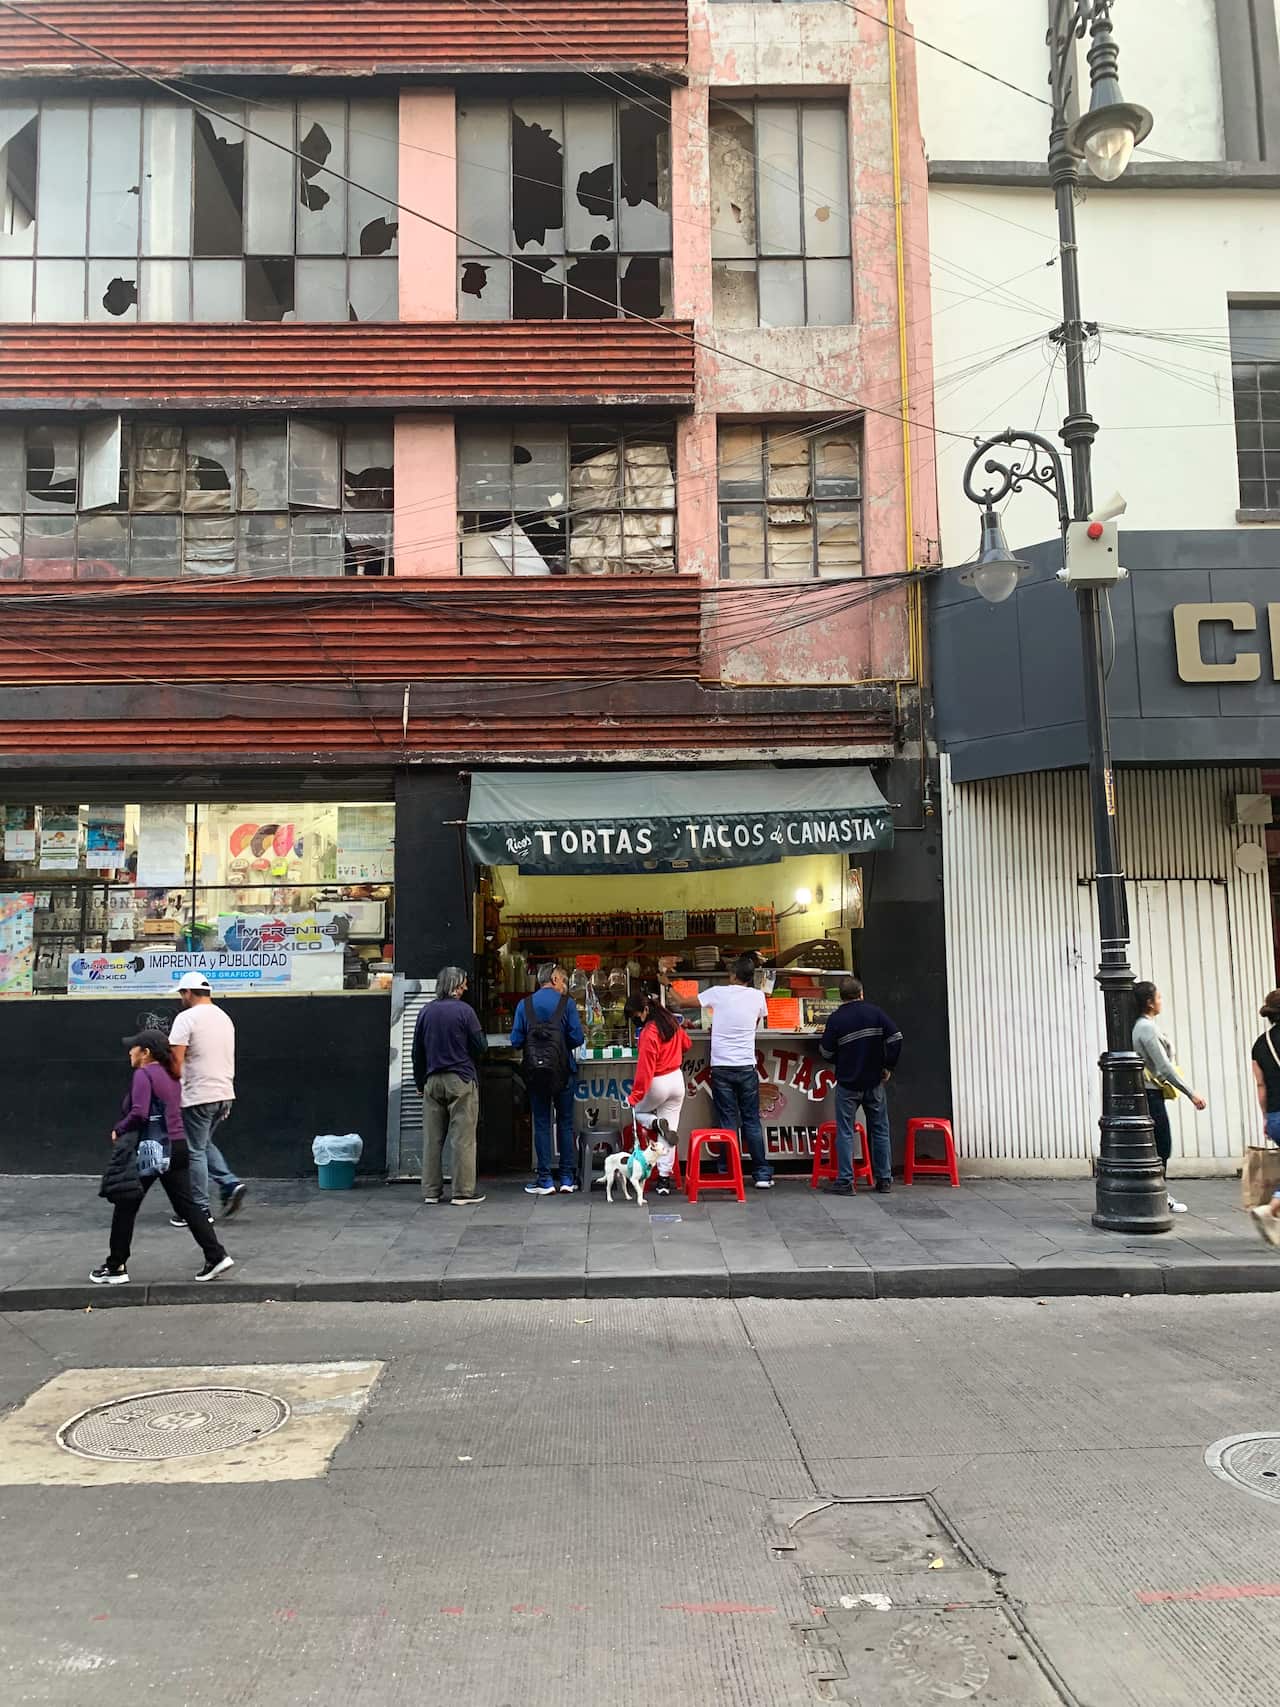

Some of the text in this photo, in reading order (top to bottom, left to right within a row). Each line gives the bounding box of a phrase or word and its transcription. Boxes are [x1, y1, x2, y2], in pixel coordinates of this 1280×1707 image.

[506, 835, 532, 854] Ricos
[535, 829, 653, 855] TORTAS
[150, 953, 287, 968] IMPRENTA y PUBLICIDAD
[574, 1078, 636, 1109] GUAS
